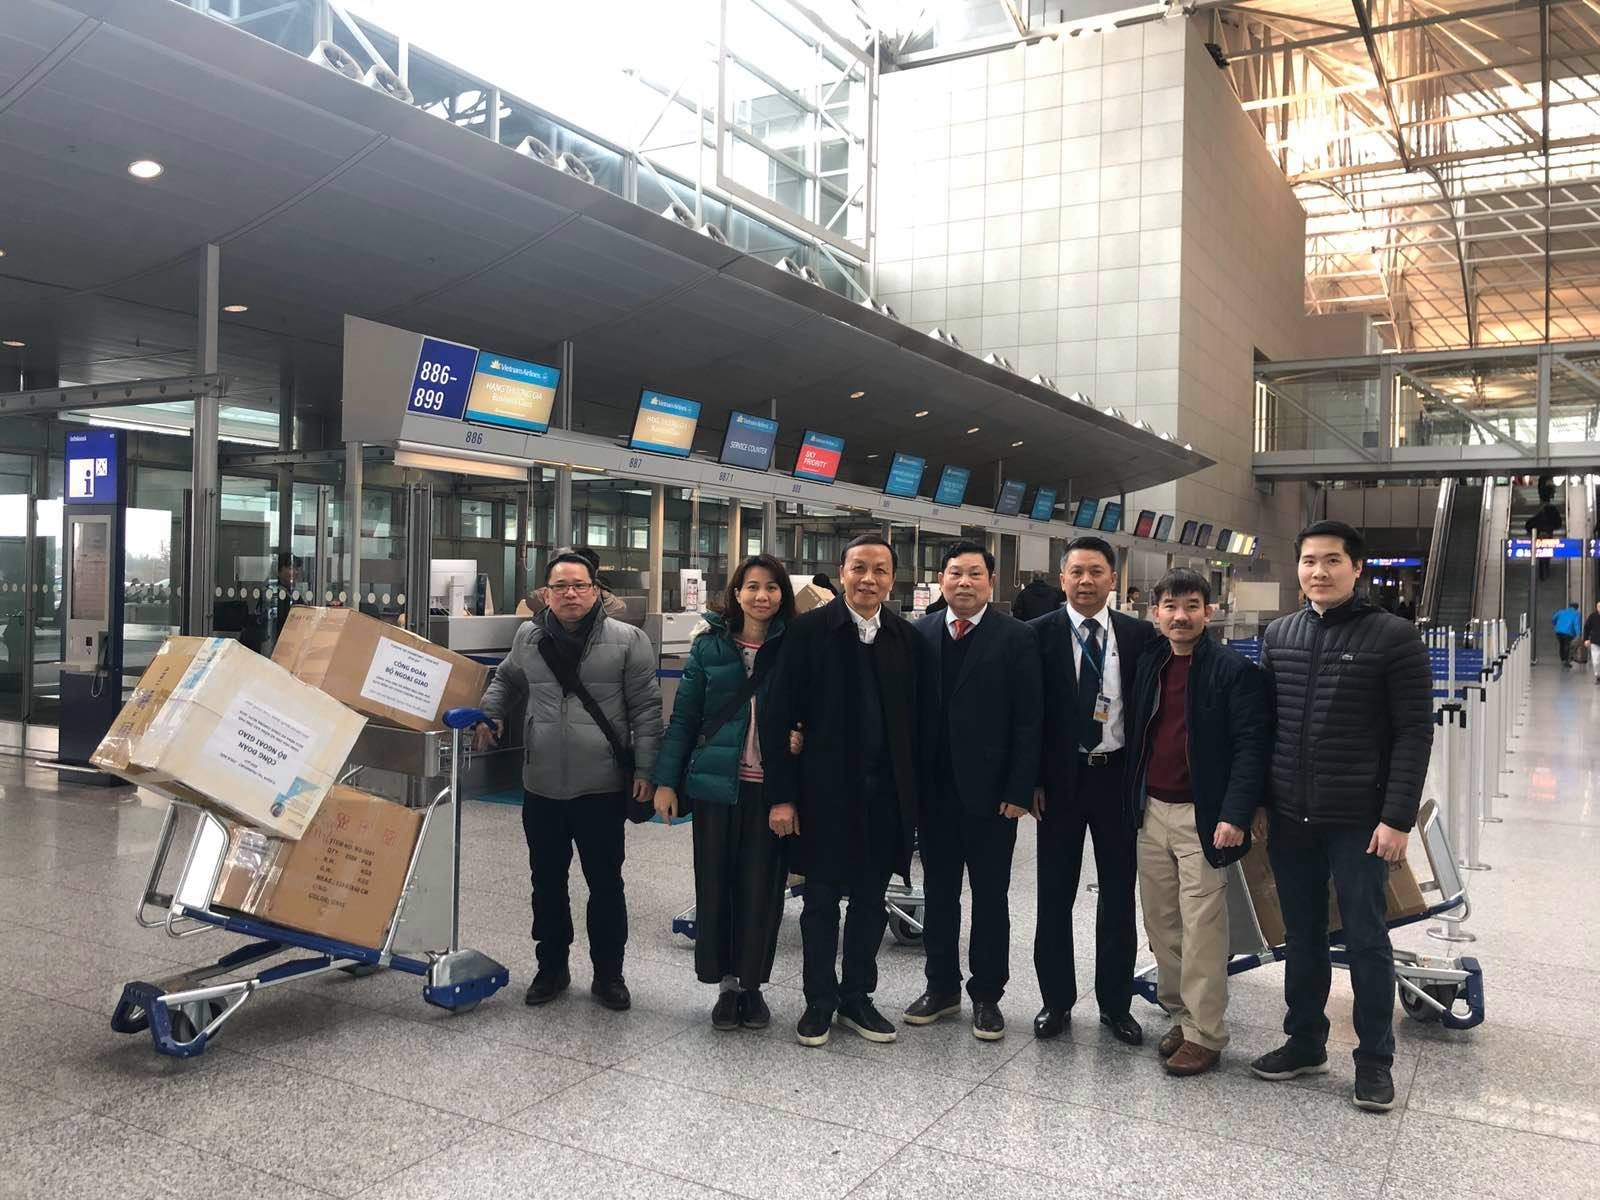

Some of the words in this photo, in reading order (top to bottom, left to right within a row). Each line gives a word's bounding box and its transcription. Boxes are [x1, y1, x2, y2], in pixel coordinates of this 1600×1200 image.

[420, 361, 457, 384] 886-
[414, 388, 444, 410] 899
[466, 431, 483, 444] 886
[730, 441, 748, 452] SERVICE
[748, 444, 768, 455] COUNTER
[629, 457, 642, 469] 887
[414, 678, 428, 688] GIAO
